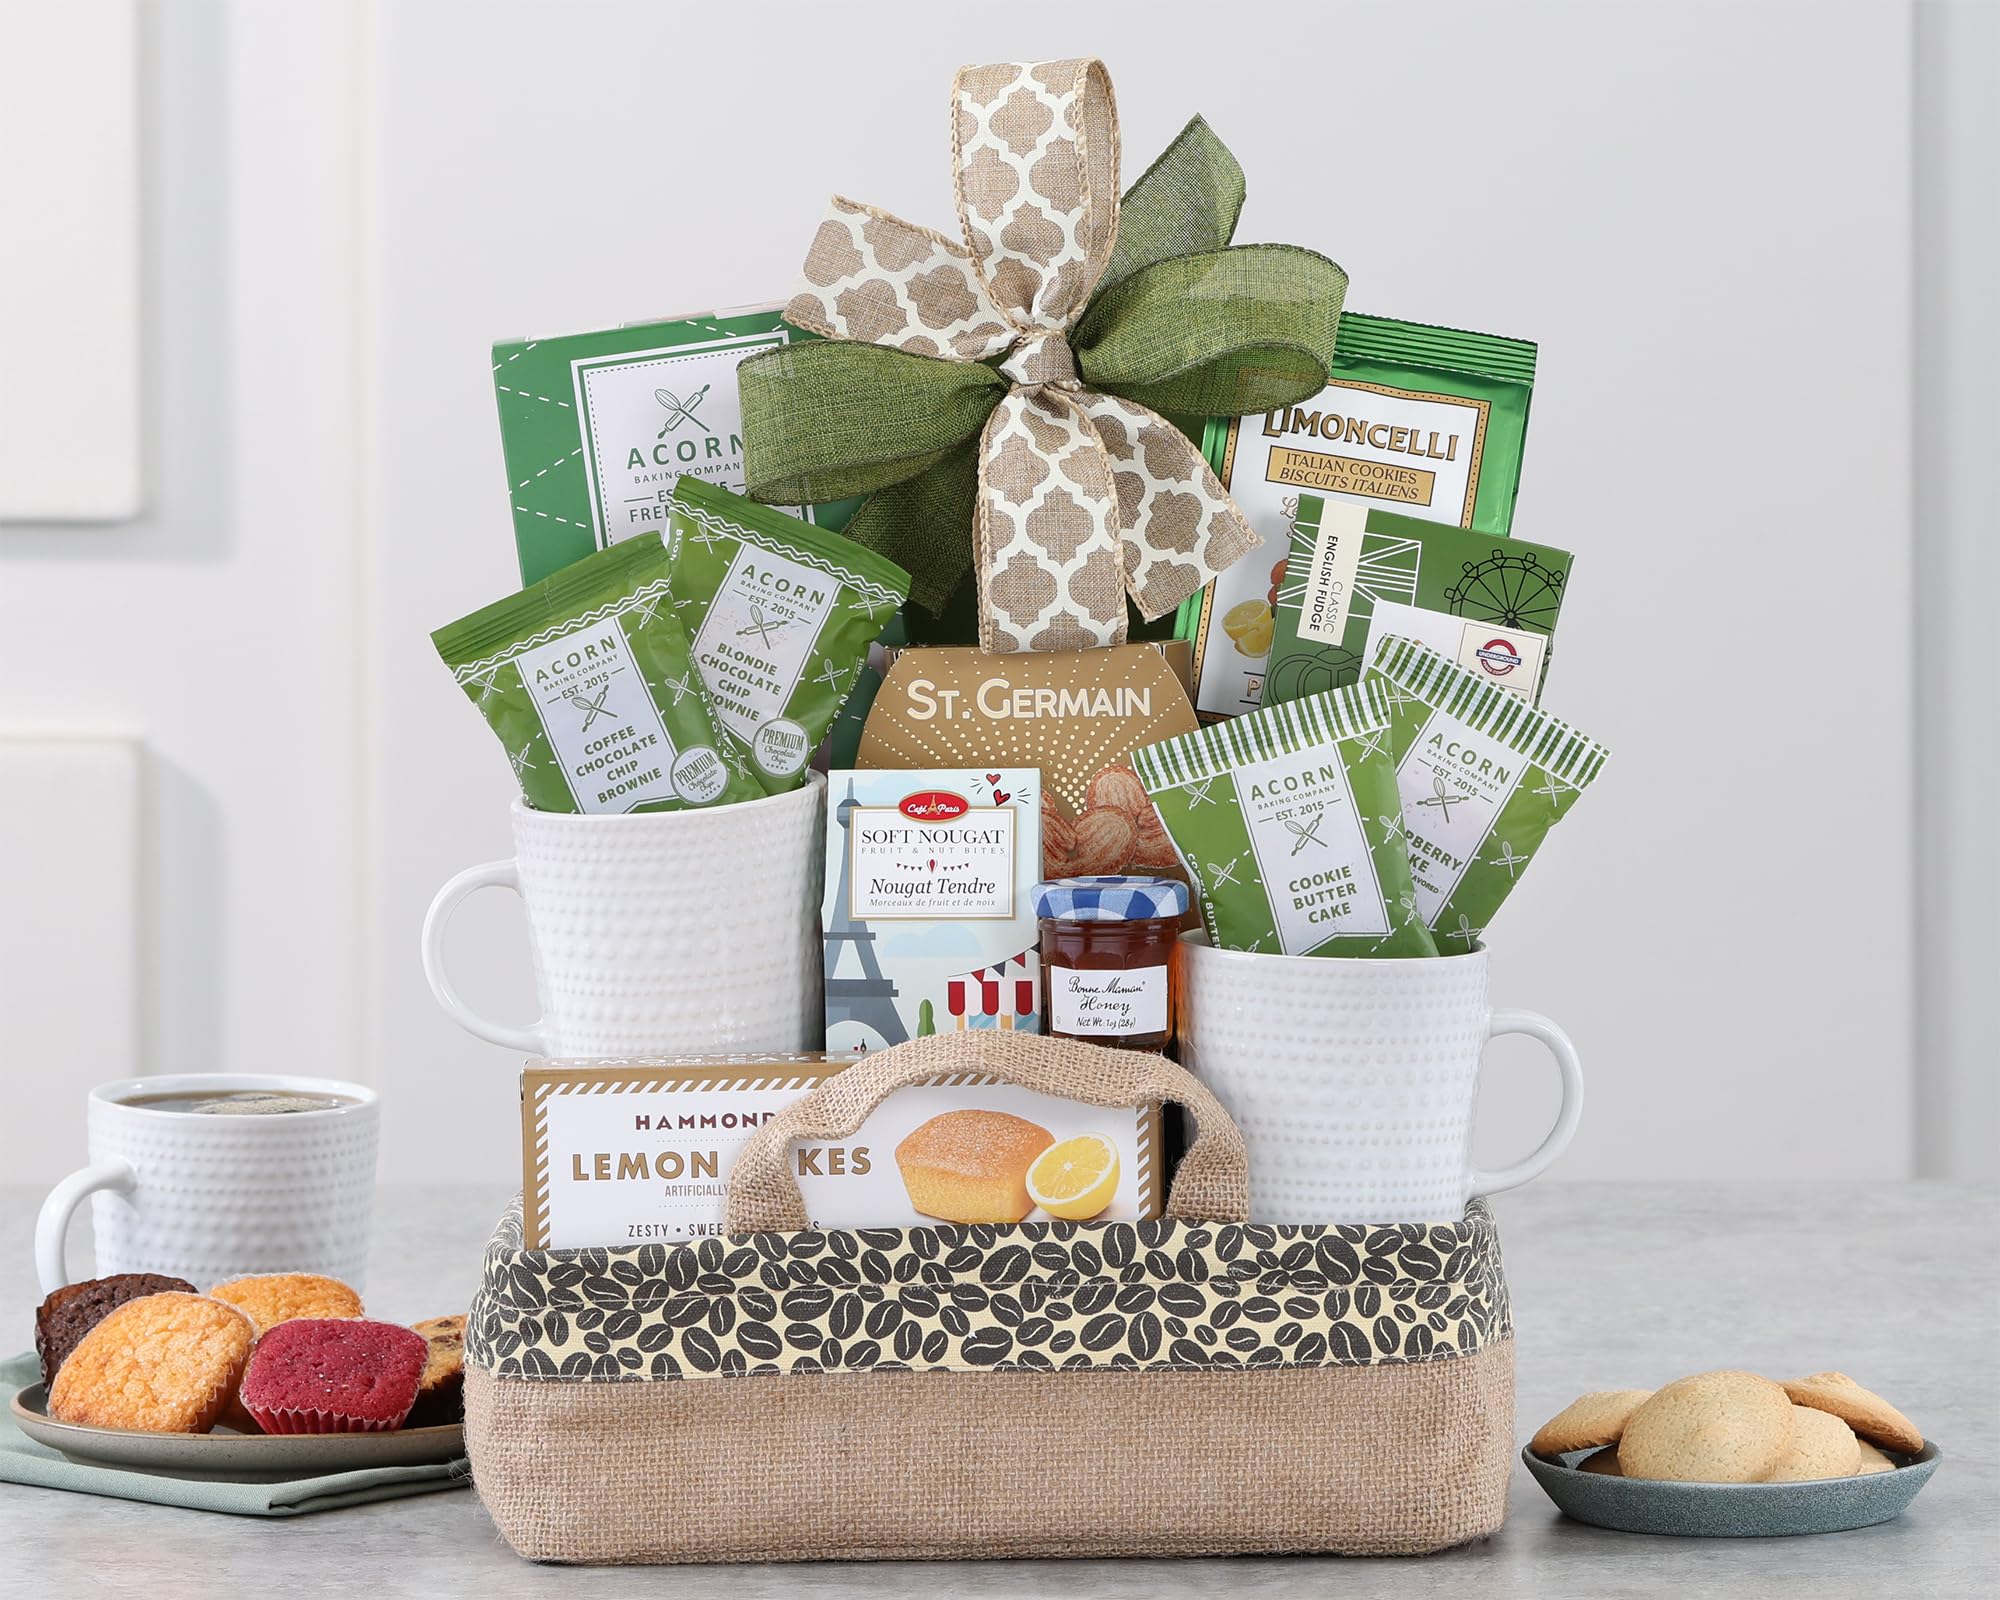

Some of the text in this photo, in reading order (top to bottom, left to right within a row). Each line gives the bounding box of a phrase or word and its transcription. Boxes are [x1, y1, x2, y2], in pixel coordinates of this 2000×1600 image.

[1262, 407, 1459, 461] LIMONCELLI
[627, 434, 744, 469] ACORN
[634, 462, 741, 484] BAKING COMPAN
[1279, 467, 1419, 499] BISCUITS ITALIENS
[1286, 452, 1417, 484] ITALIAN COOKIES
[740, 579, 816, 614] BAKING COMPANY
[741, 564, 825, 606] ACORN
[1309, 535, 1338, 632] ENGLISH FUDGE
[748, 594, 796, 621] EST. 2015
[1323, 581, 1343, 634] CLASSIC
[536, 635, 617, 684] ACORN
[544, 654, 618, 692] BAKING COMPANY
[700, 653, 782, 696] CHOCOLATE
[717, 643, 778, 677] BLONDIE
[561, 671, 610, 700] EST. 2015
[718, 679, 751, 698] CHIP
[709, 691, 760, 721] OWNIE
[584, 725, 636, 755] COFFEE
[762, 727, 805, 751] PREMIUM
[764, 745, 797, 759] Chocolate
[575, 734, 658, 777] CHOCOLATE
[606, 760, 639, 781] CHIP
[674, 751, 717, 786] PREMIUM
[1429, 733, 1510, 784] ACORN
[597, 768, 662, 804] BROWNIE
[688, 769, 718, 791] Chocolate
[1251, 764, 1335, 801] ACORN
[1426, 749, 1499, 793] BAKING COMPANY
[1432, 765, 1479, 797] EST. 2015
[937, 803, 960, 813] Paris
[1257, 784, 1336, 810] BAKING COMPANY
[1275, 801, 1324, 821] EST. 2015
[861, 829, 1005, 844] SOFT NOUGAT
[869, 877, 996, 898] Nougat Tendre
[1289, 866, 1352, 893] COOKIE
[869, 899, 996, 907] Morceaux de fruit et de noix
[1293, 882, 1358, 910] BUTTER
[1308, 902, 1352, 923] CAKE
[1069, 976, 1100, 993] Bonne
[1080, 995, 1131, 1016] Honey
[1076, 1017, 1090, 1026] Net
[573, 1147, 872, 1181] LEMON KES
[628, 1223, 723, 1237] ZESTY SWEE
